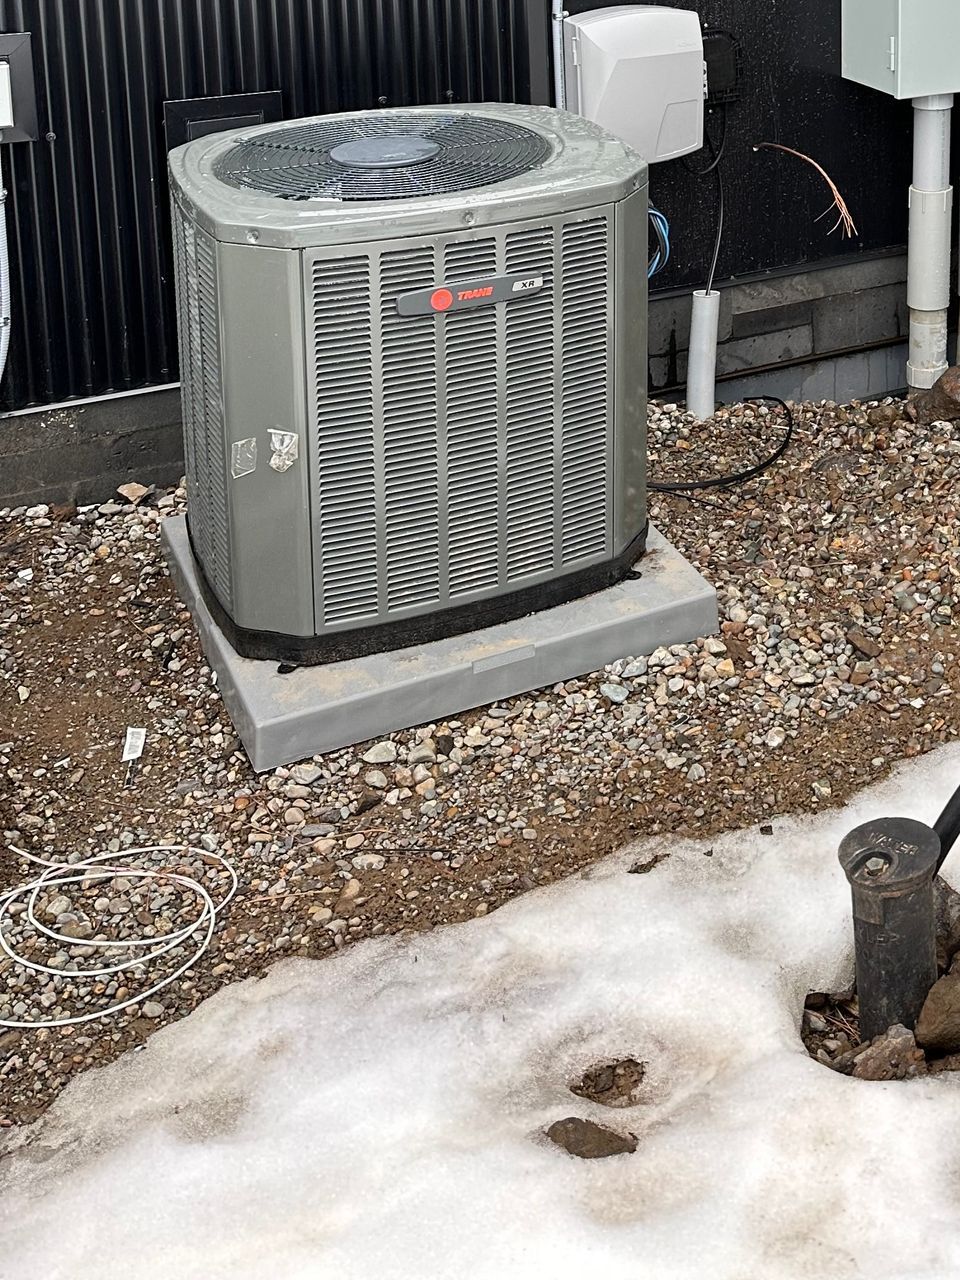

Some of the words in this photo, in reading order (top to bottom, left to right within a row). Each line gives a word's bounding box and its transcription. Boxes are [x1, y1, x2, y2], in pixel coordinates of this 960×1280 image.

[520, 280, 535, 289] XR
[457, 286, 493, 300] TRANE
[868, 831, 920, 855] WATER
